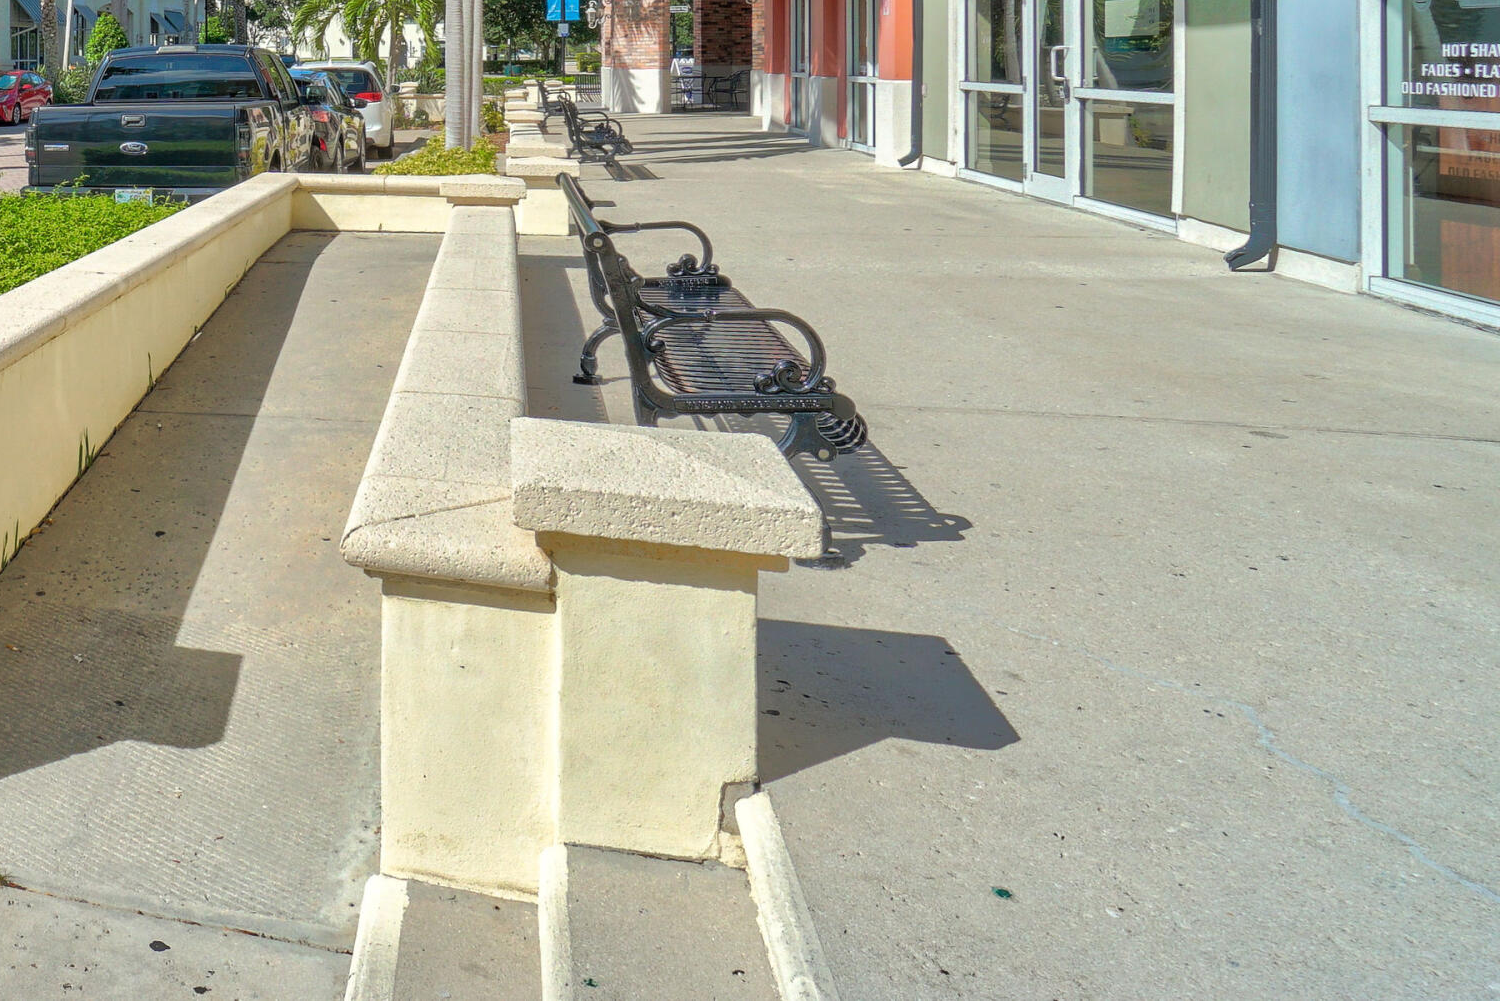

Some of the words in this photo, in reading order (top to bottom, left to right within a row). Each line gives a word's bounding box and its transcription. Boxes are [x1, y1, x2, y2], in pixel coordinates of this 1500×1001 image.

[1441, 43, 1468, 58] HOT
[1421, 63, 1461, 77] FADES
[1402, 81, 1423, 95] OLD
[1425, 82, 1496, 98] FASHIONED
